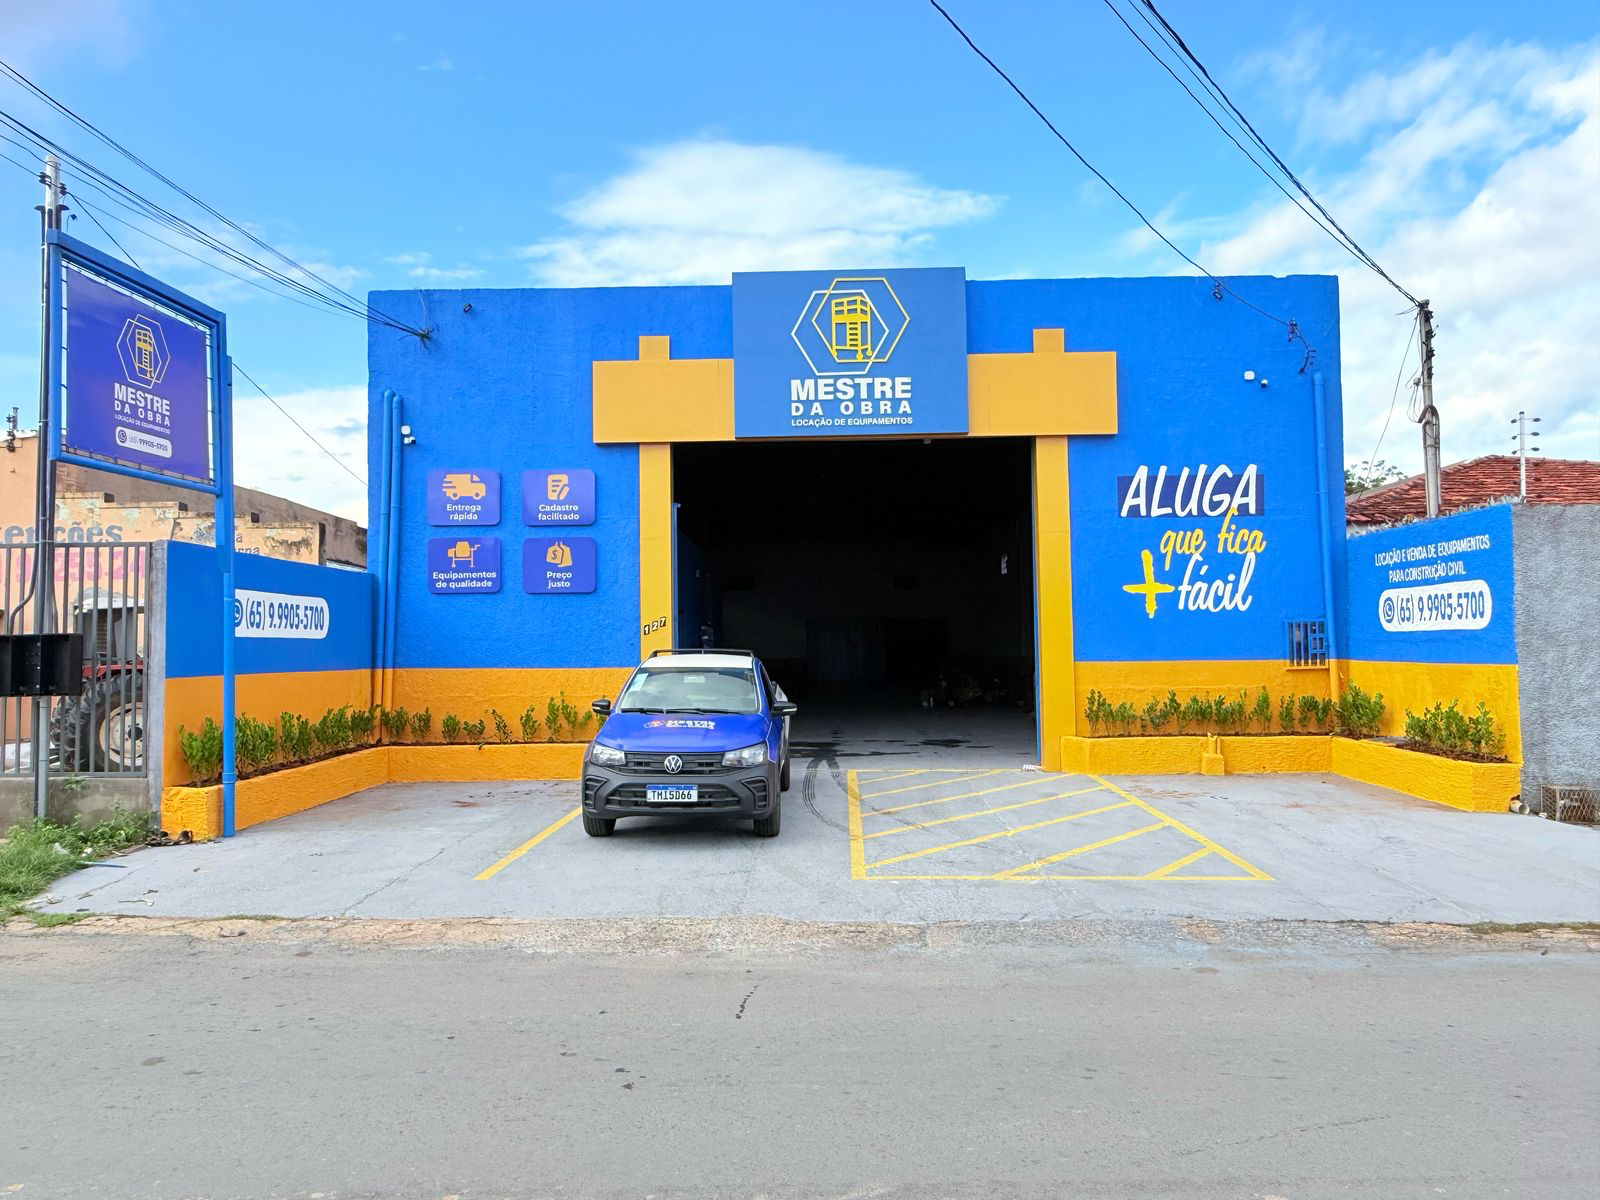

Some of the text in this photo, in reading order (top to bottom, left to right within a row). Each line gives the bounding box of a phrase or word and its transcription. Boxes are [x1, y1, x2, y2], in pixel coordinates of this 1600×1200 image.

[790, 376, 912, 401] MESTRE
[114, 382, 170, 416] MESTRE
[791, 400, 912, 416] DA OBRA
[114, 400, 170, 427] DA OBRA
[791, 417, 913, 428] LOCAÇÃO DE EQUIPAMENTOS
[1120, 463, 1258, 518] ALUGA
[446, 503, 482, 513] Entrega
[450, 512, 478, 521] rápida
[538, 503, 579, 512] Cadastro
[538, 512, 580, 521] facilitado
[1160, 506, 1267, 571] que fica
[1374, 534, 1490, 567] LOCAÇÃO E VENDA DE EQUIPAMENTOS
[432, 571, 497, 581] Equipamentos
[546, 571, 572, 581] Preço
[1388, 561, 1466, 583] PARA CONSTRUÇÃO CIVIL
[435, 580, 493, 589] de qualidade
[547, 580, 571, 589] justo
[1177, 551, 1253, 613] fácil
[246, 598, 325, 631] (65) 9.9905-5700
[1396, 590, 1485, 625] (65) 9.9905-5700
[643, 616, 667, 635] 127
